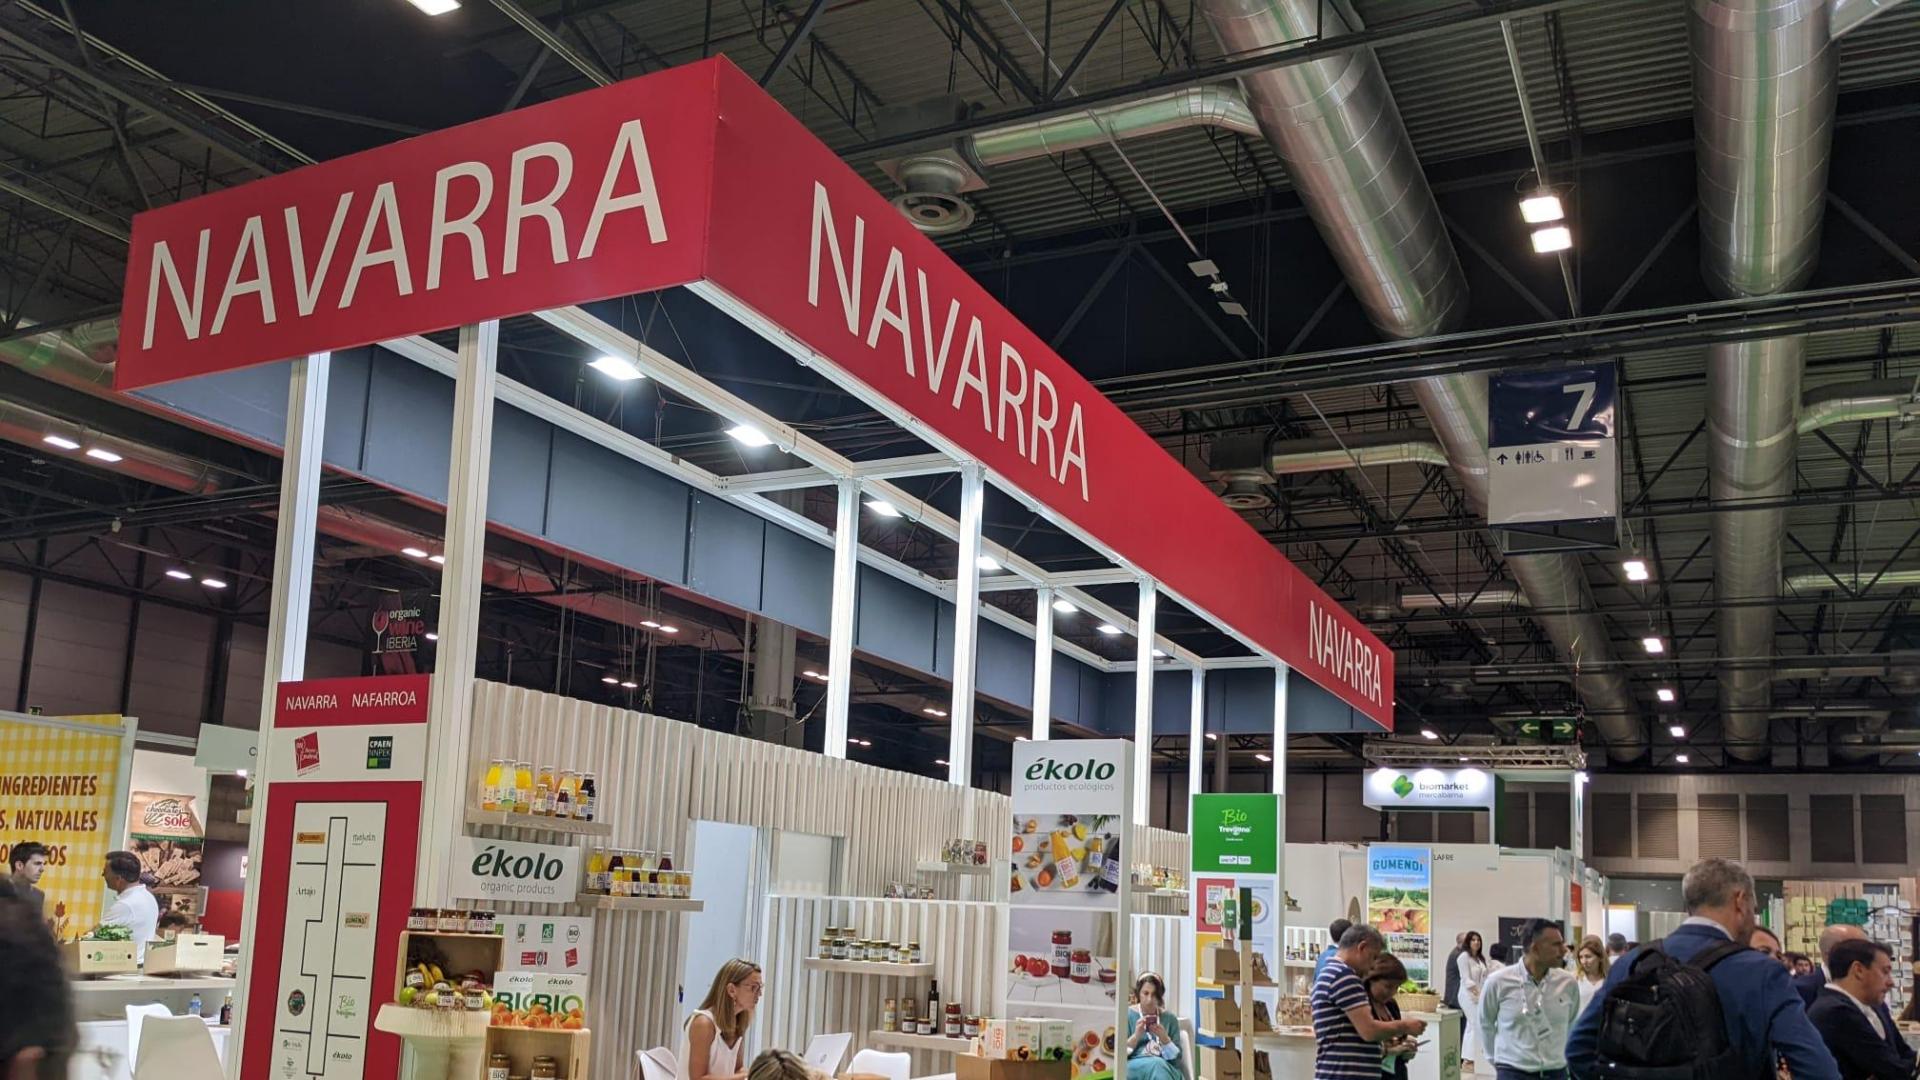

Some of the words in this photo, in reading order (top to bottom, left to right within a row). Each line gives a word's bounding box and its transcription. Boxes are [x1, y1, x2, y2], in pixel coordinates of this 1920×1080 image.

[143, 119, 668, 350] NAVARRA
[808, 180, 1089, 502] NAVARRA
[1563, 381, 1597, 431] 7
[390, 606, 421, 621] organic
[389, 620, 425, 636] wine
[386, 636, 418, 649] IBERIA
[1309, 600, 1382, 708] NAVARRA
[286, 694, 338, 711] NAVARRA
[351, 690, 417, 708] NAFARROA
[369, 740, 392, 748] CPAEN
[1025, 757, 1115, 780] ékolo
[1024, 783, 1067, 792] productos
[1068, 782, 1115, 792] ecológicos
[1419, 782, 1469, 790] biomarket
[15, 810, 98, 831] NATURALES
[1221, 808, 1248, 826] Bio
[471, 845, 564, 881] ékolo
[480, 881, 514, 894] organic
[516, 883, 556, 895] products
[508, 975, 534, 983] ékolo
[547, 977, 574, 985] ékolo
[534, 993, 584, 1016] BIO
